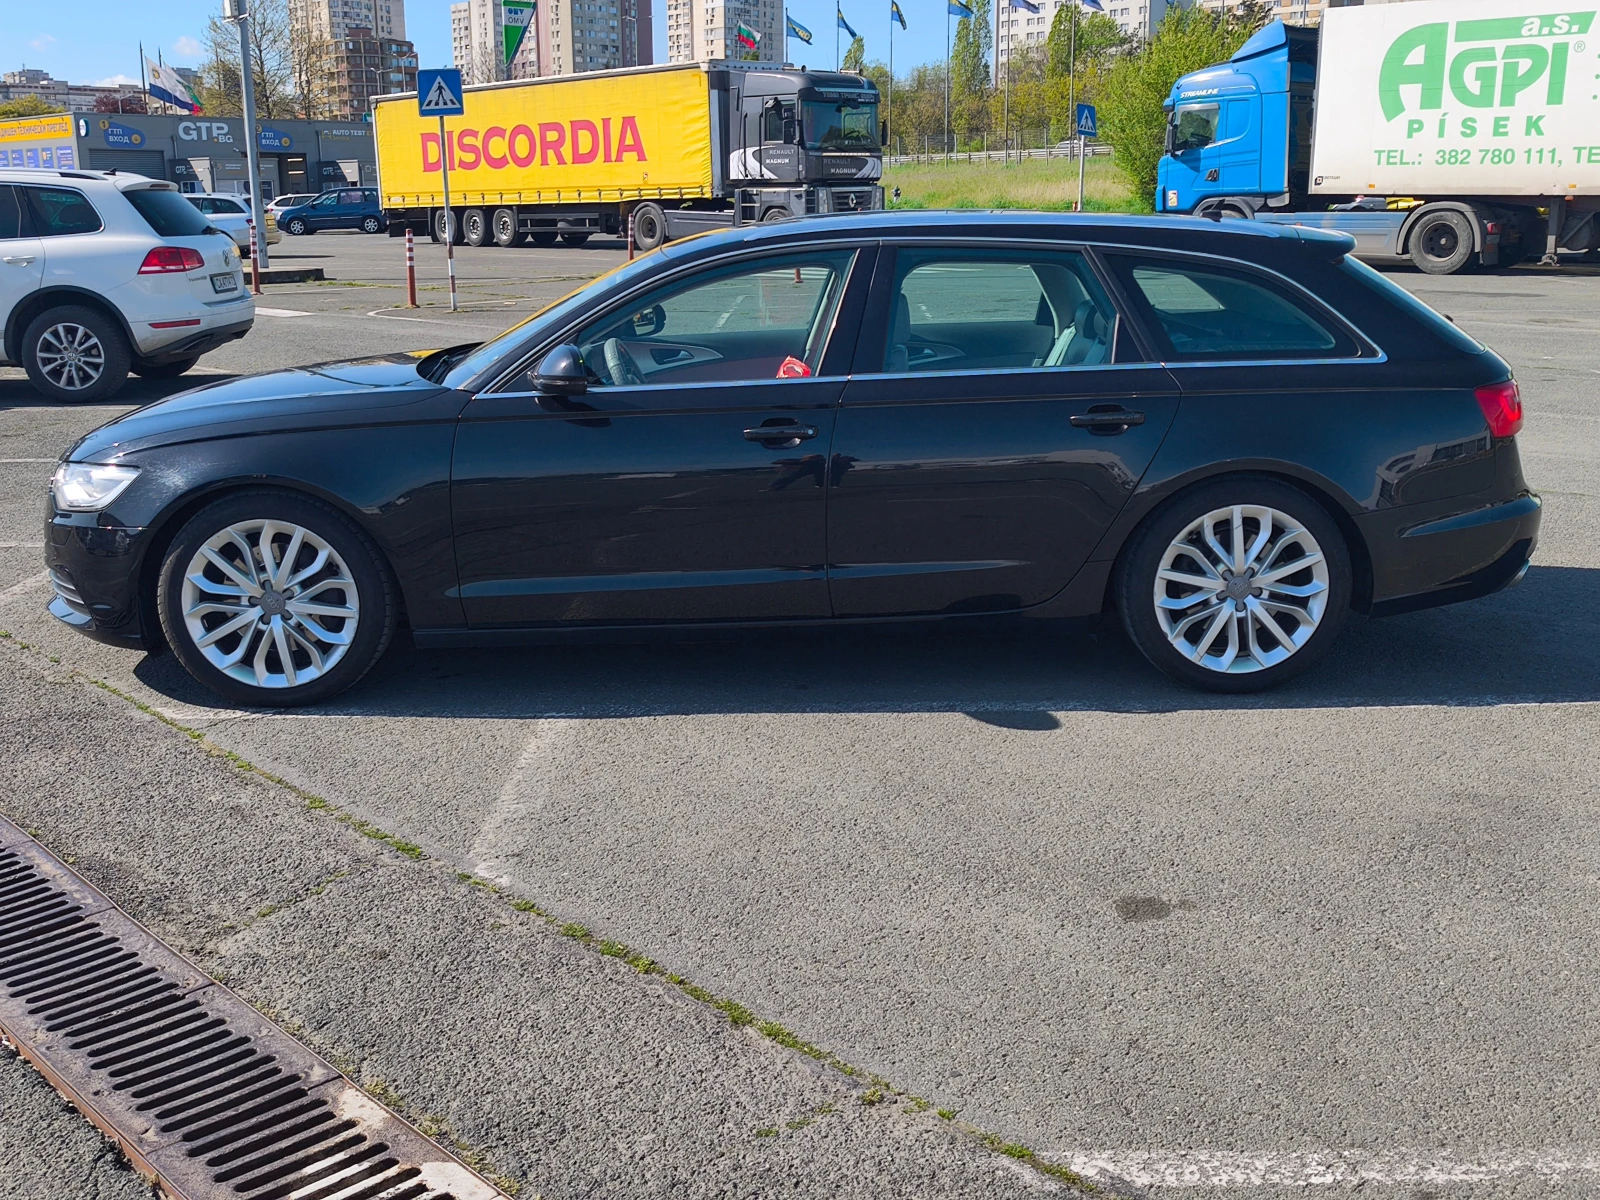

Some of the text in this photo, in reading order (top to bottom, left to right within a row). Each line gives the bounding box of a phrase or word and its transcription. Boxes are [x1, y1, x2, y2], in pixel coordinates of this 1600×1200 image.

[507, 7, 525, 16] OMV
[507, 16, 525, 25] OMV
[1520, 14, 1580, 37] a.s.
[1378, 21, 1570, 123] AGPI
[1179, 87, 1220, 99] STREAMLINE
[1406, 112, 1546, 139] PÍSEK
[108, 135, 130, 144] ВХОД
[420, 115, 648, 173] DISCORDIA
[1374, 146, 1600, 168] TEL.: 382 780 111, TE
